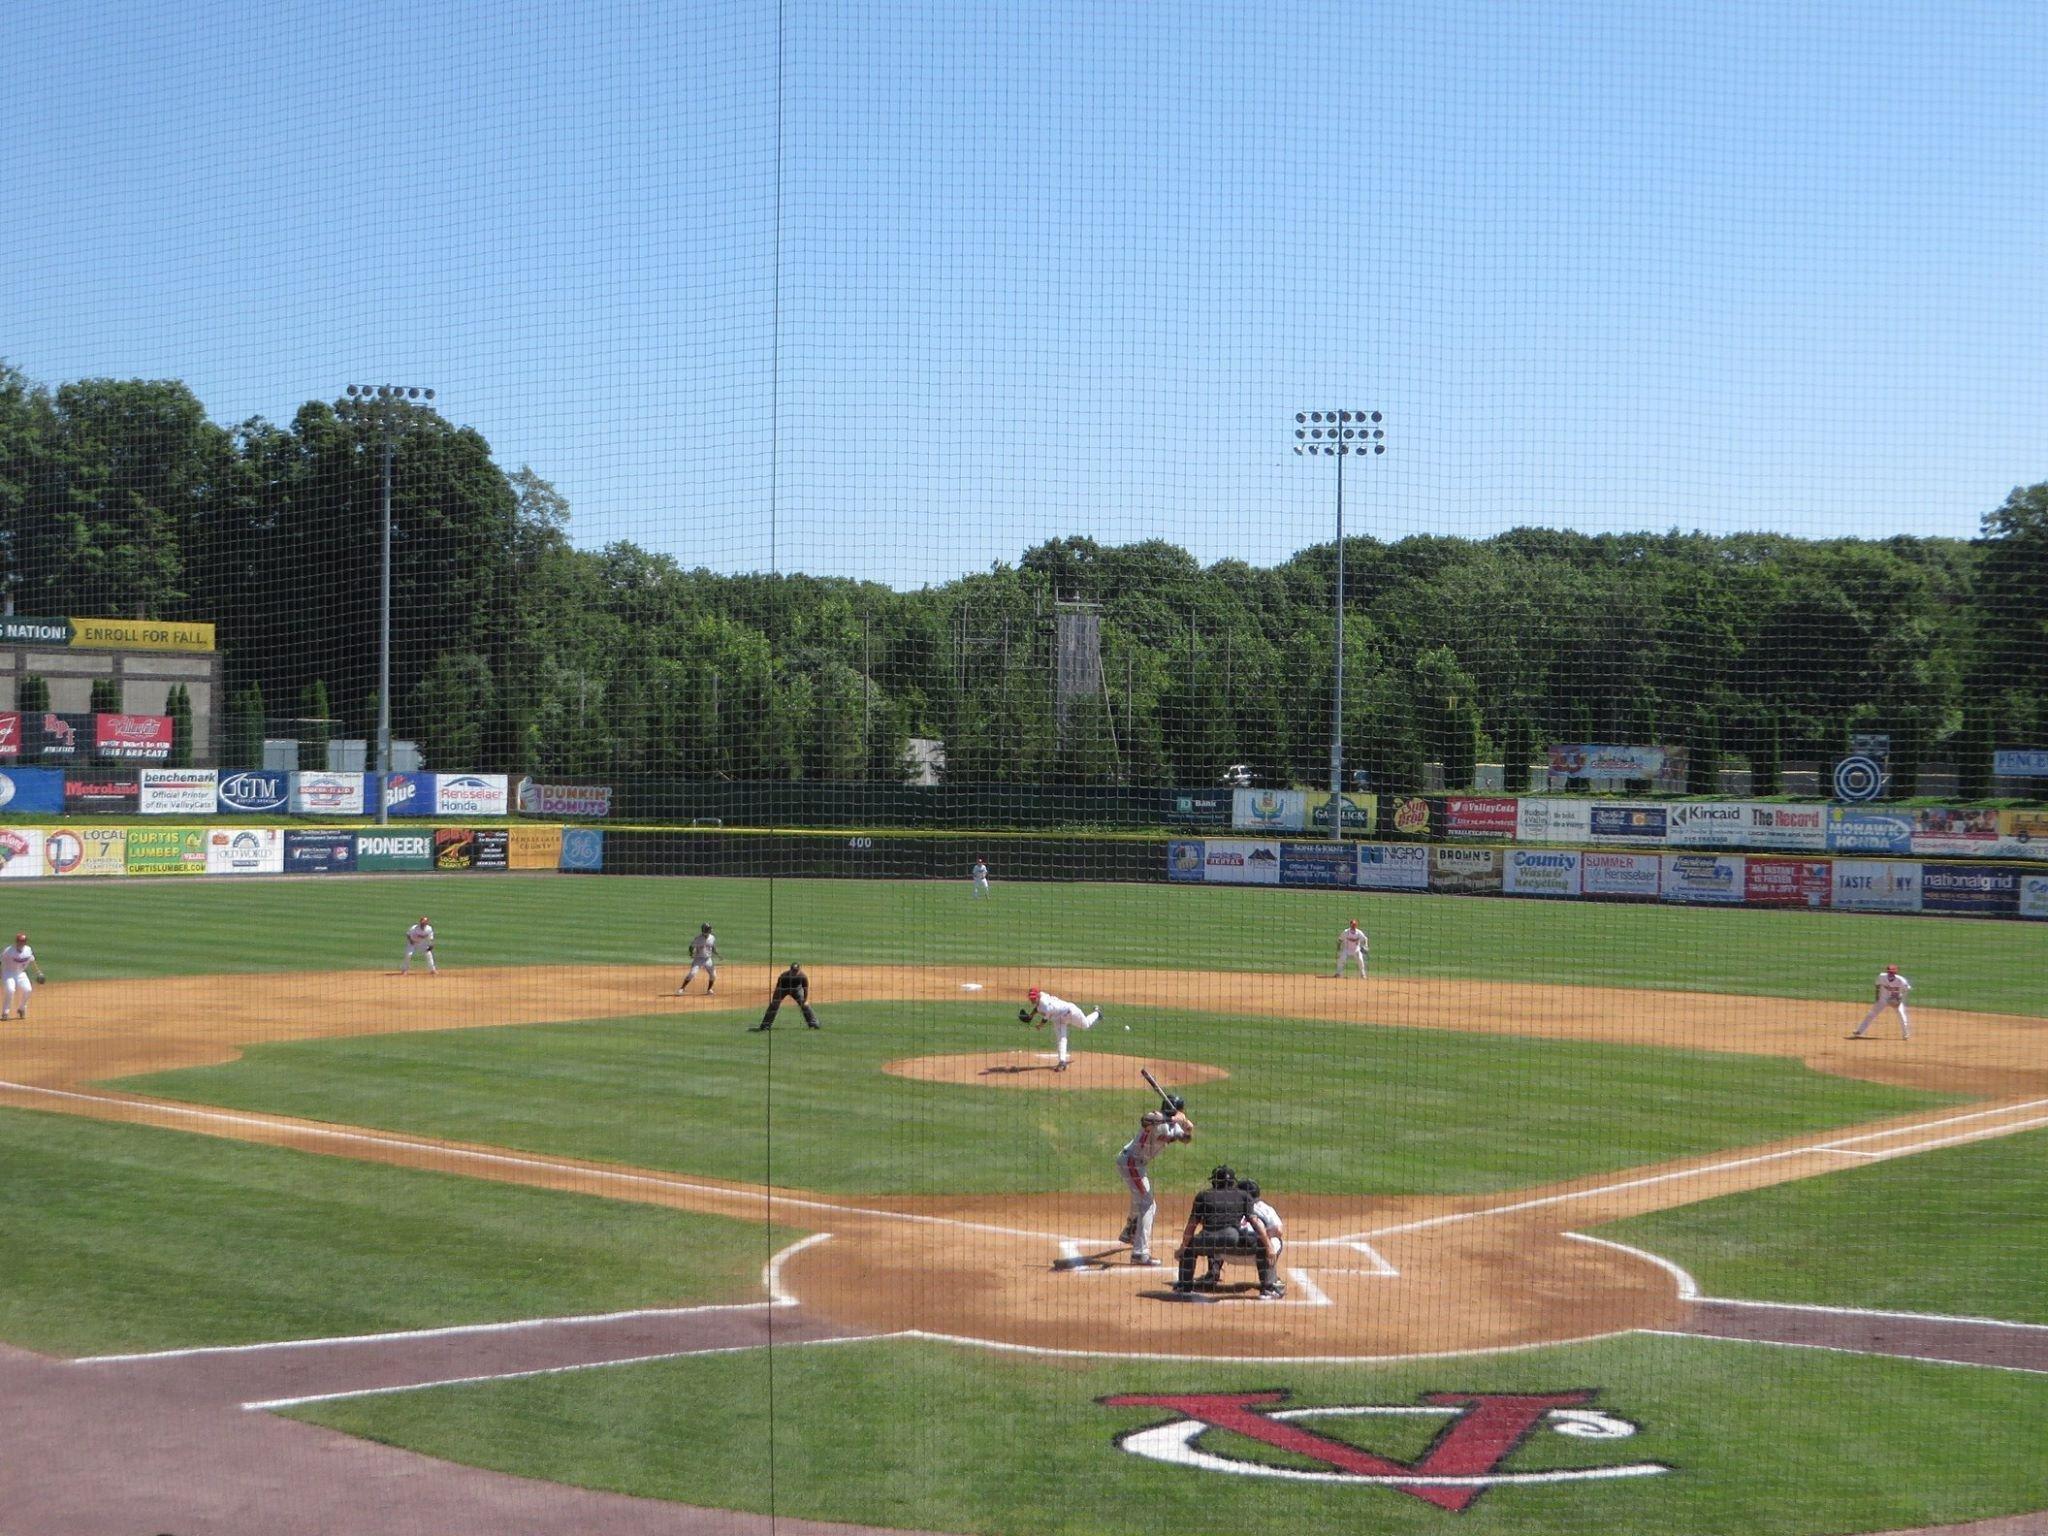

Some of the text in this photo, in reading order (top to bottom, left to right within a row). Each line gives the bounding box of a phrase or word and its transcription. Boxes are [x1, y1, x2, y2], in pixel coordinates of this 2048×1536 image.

[7, 624, 67, 639] NATION!
[85, 627, 207, 644] ENROLL FOR FALL.
[144, 772, 216, 783] benchemark
[152, 790, 209, 799] Official Printer
[238, 778, 276, 799] GTM
[441, 789, 503, 800] Rensselaer
[385, 784, 416, 807] Blue
[441, 801, 478, 811] Honda
[1689, 806, 1740, 820] Kincaid
[1752, 808, 1820, 828] The Record
[83, 830, 126, 840] LOCAL
[1829, 823, 1900, 836] MOHAWK
[129, 832, 180, 844] CURTIS
[848, 837, 872, 848] 400
[1836, 836, 1890, 847] HONDA
[100, 842, 110, 856] 7
[358, 837, 424, 855] PIONEER
[129, 847, 180, 858] LUMBER
[1384, 847, 1425, 860] NIGRO
[1439, 850, 1491, 861] BROWN'S
[1514, 852, 1576, 870] County
[1586, 856, 1633, 868] SUMMER
[129, 864, 206, 872] CURTISLUMBER.COM
[1604, 868, 1656, 880] Rensselaer
[1839, 875, 1872, 889] TASTE
[1924, 873, 2013, 891] nationalgrid
